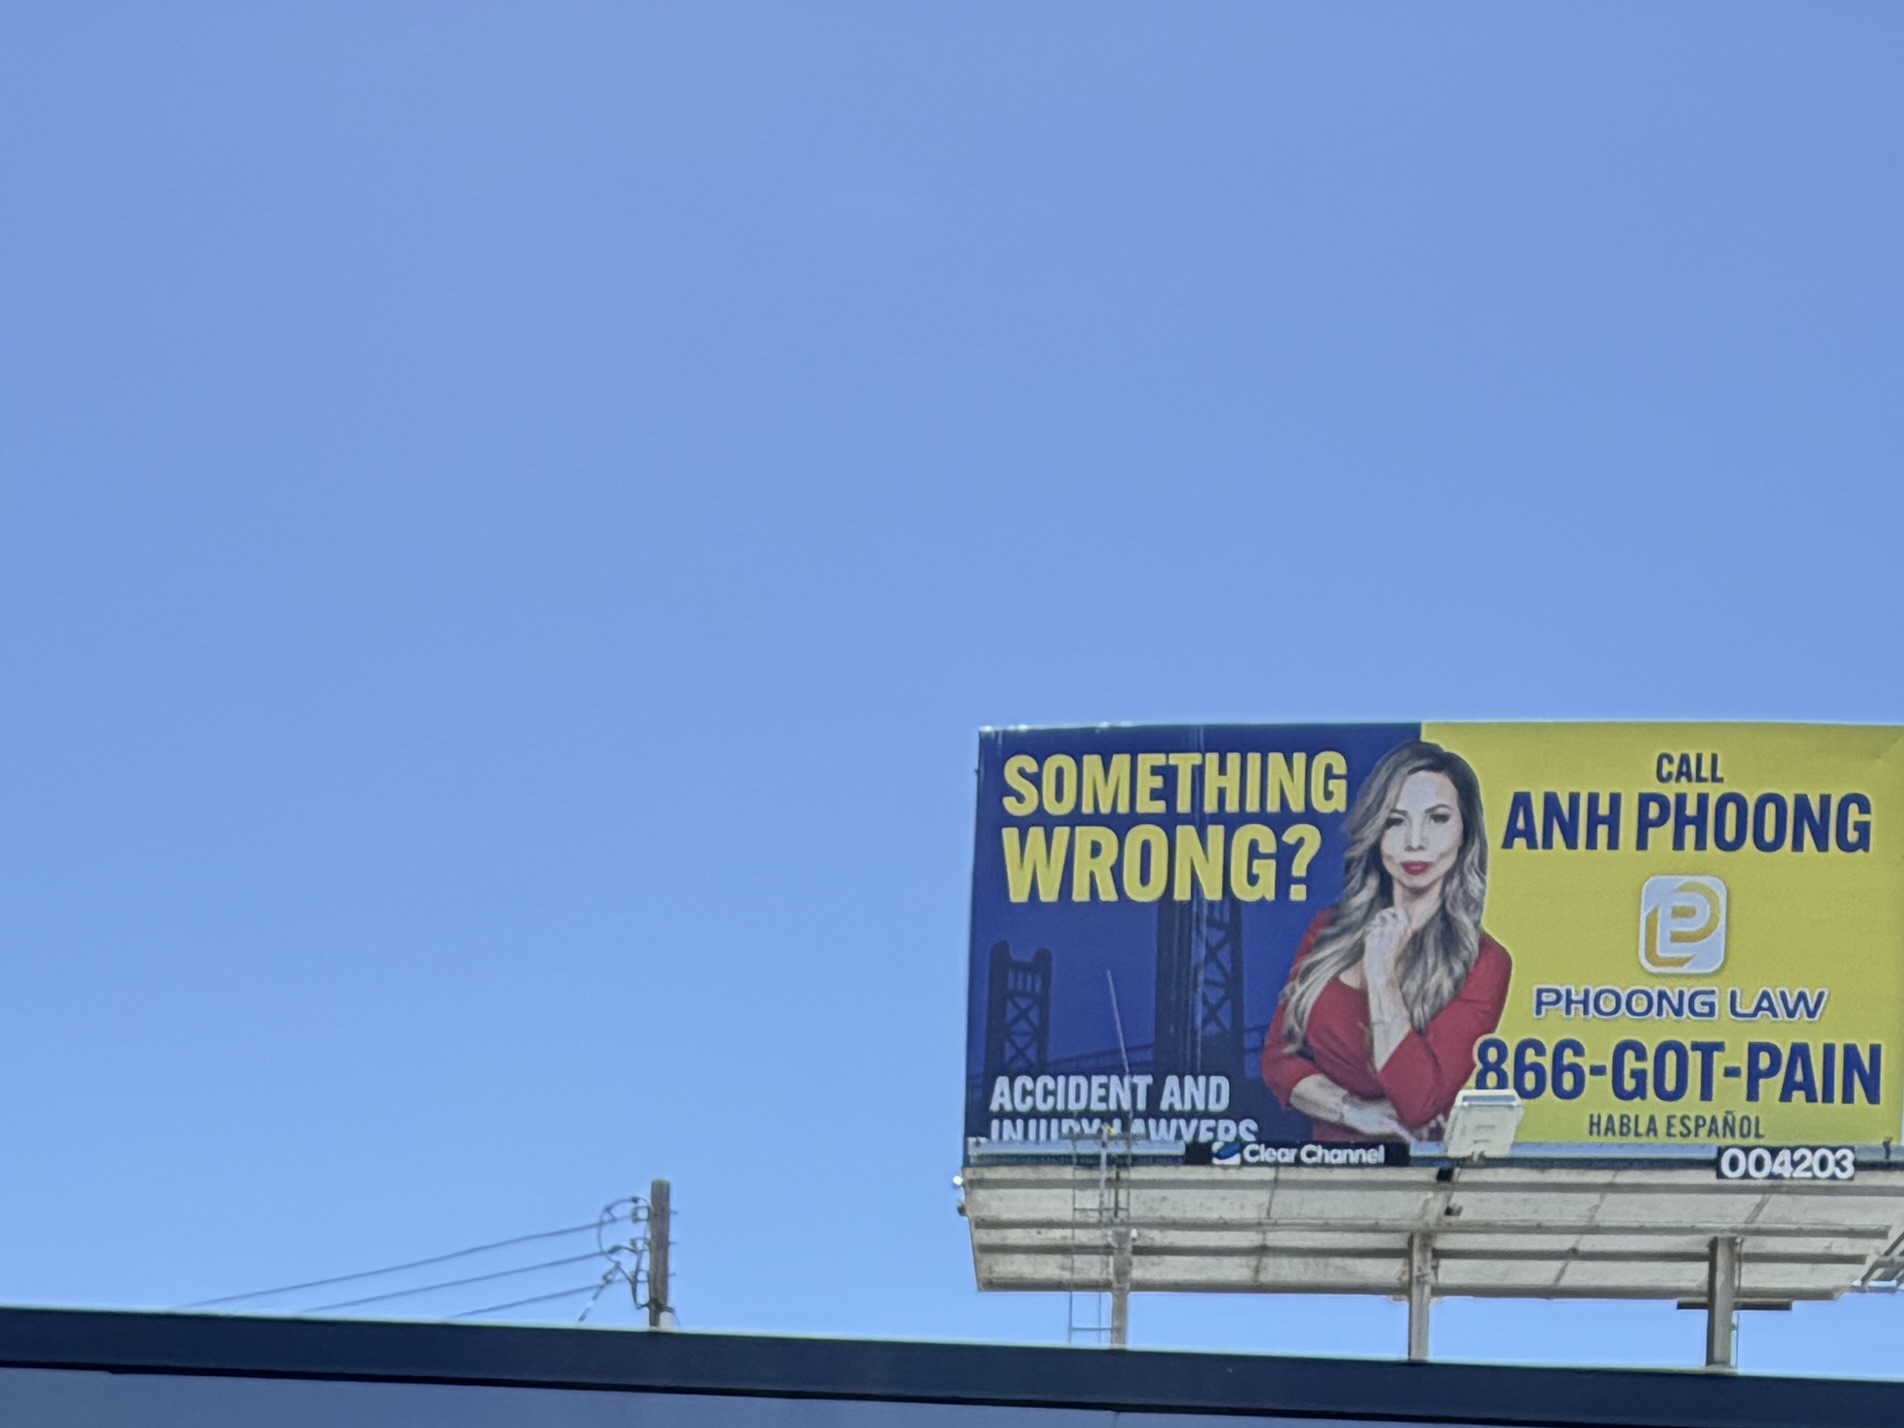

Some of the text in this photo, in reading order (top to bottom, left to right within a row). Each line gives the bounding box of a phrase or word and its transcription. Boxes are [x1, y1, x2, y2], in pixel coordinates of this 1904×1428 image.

[1001, 750, 1348, 817] SOMETHING
[1655, 752, 1724, 784] CALL
[1501, 791, 1873, 854] ANH PHOONG
[1001, 823, 1322, 903] WRONG?
[1533, 987, 1828, 1020] PHOONG LAW
[1474, 1037, 1883, 1106] 866-GOT-PAIN
[988, 1074, 1231, 1113] ACCIDENT AND
[1588, 1110, 1766, 1140] HABLA ESPAÑOL
[1244, 1143, 1386, 1165] Clear Channel
[1720, 1147, 1856, 1180] 004203
